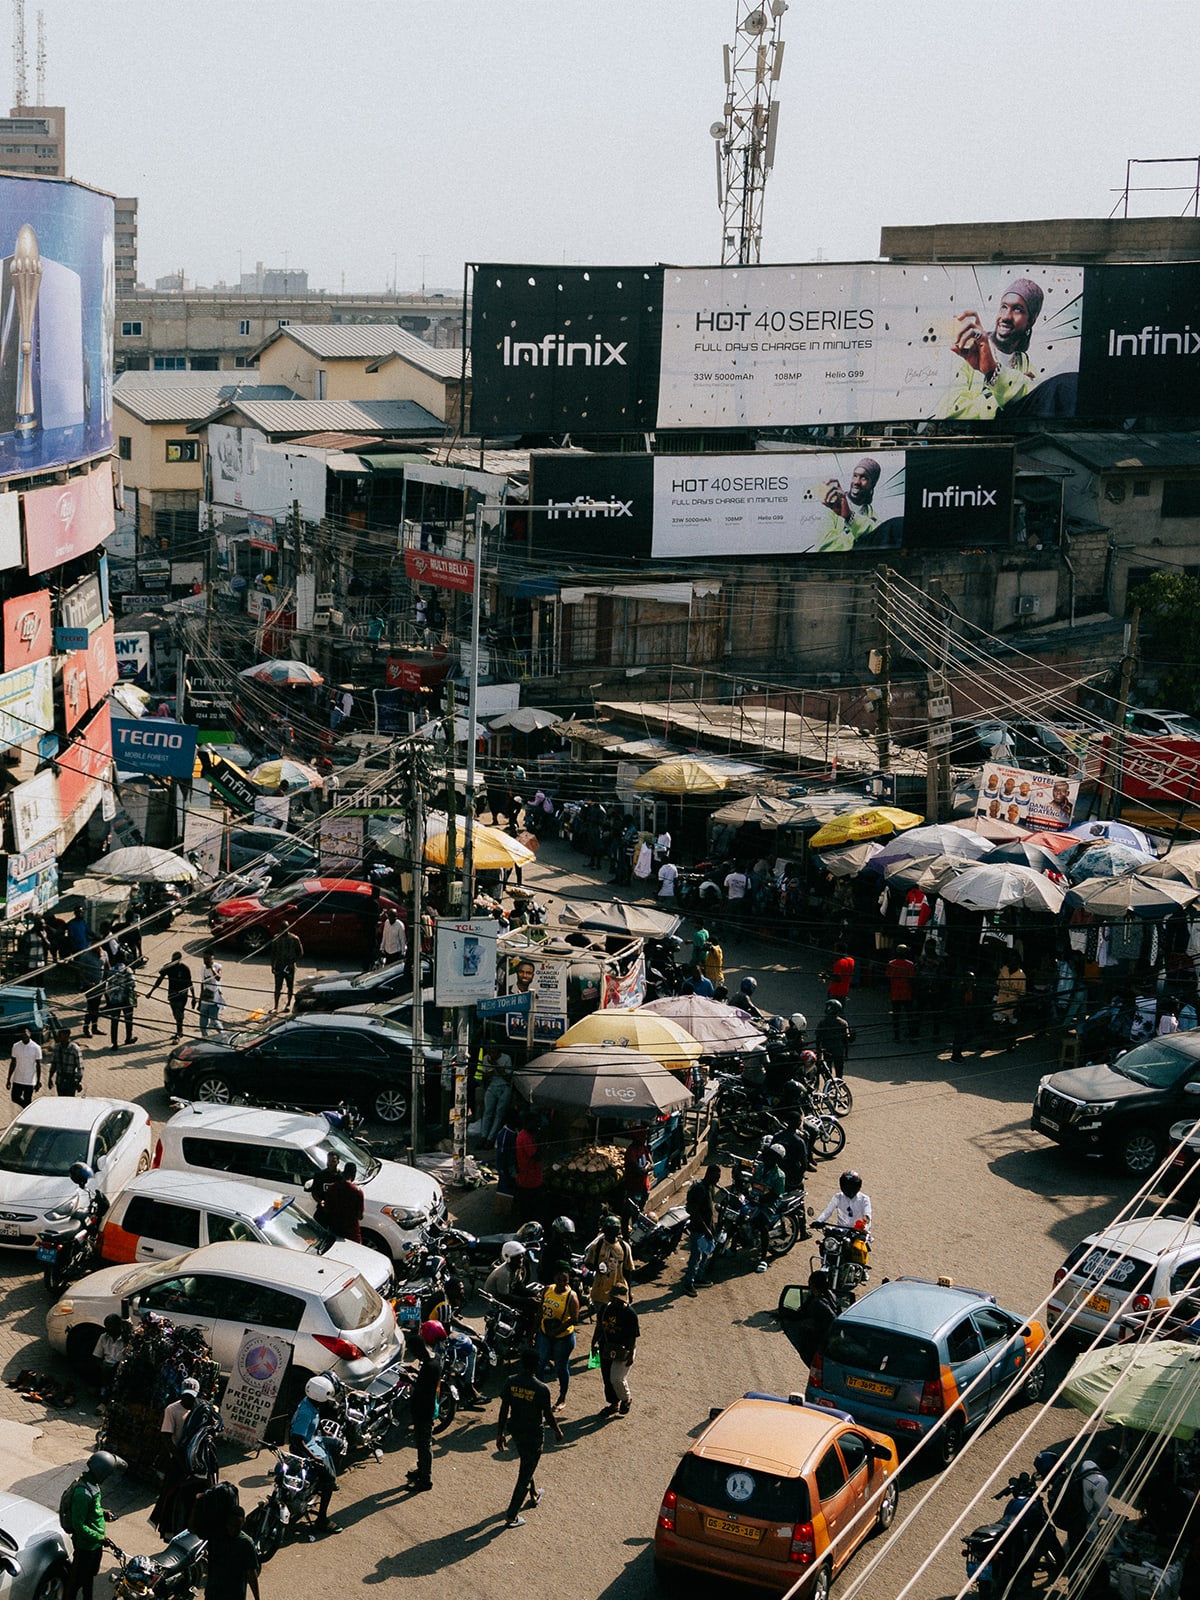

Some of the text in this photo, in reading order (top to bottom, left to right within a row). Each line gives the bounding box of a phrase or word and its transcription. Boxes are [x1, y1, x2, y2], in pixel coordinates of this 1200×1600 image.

[695, 311, 751, 332] HOT
[503, 333, 628, 367] Infinix
[694, 339, 873, 352] FULL DAY'S CHARGE IN MINUTES
[694, 373, 754, 381] 33W 5000mAh
[775, 373, 802, 381] 108MP
[825, 370, 865, 379] Helio G99
[672, 478, 709, 492] HOT
[671, 498, 690, 506] FULL
[715, 498, 742, 506] CHARGE
[755, 496, 788, 505] MINUTES
[922, 485, 997, 508] Infinix
[547, 495, 633, 521] Infinix
[430, 558, 469, 577] MULTI BELLO
[117, 728, 183, 749] TECNO
[124, 751, 169, 762] MOBILE FOREST
[605, 1087, 636, 1099] tigo
[241, 1384, 262, 1398] ECG
[226, 1388, 272, 1409] PREPAID
[236, 1400, 262, 1412] UNIT
[225, 1403, 268, 1424] VENDOR
[230, 1414, 258, 1429] HERE
